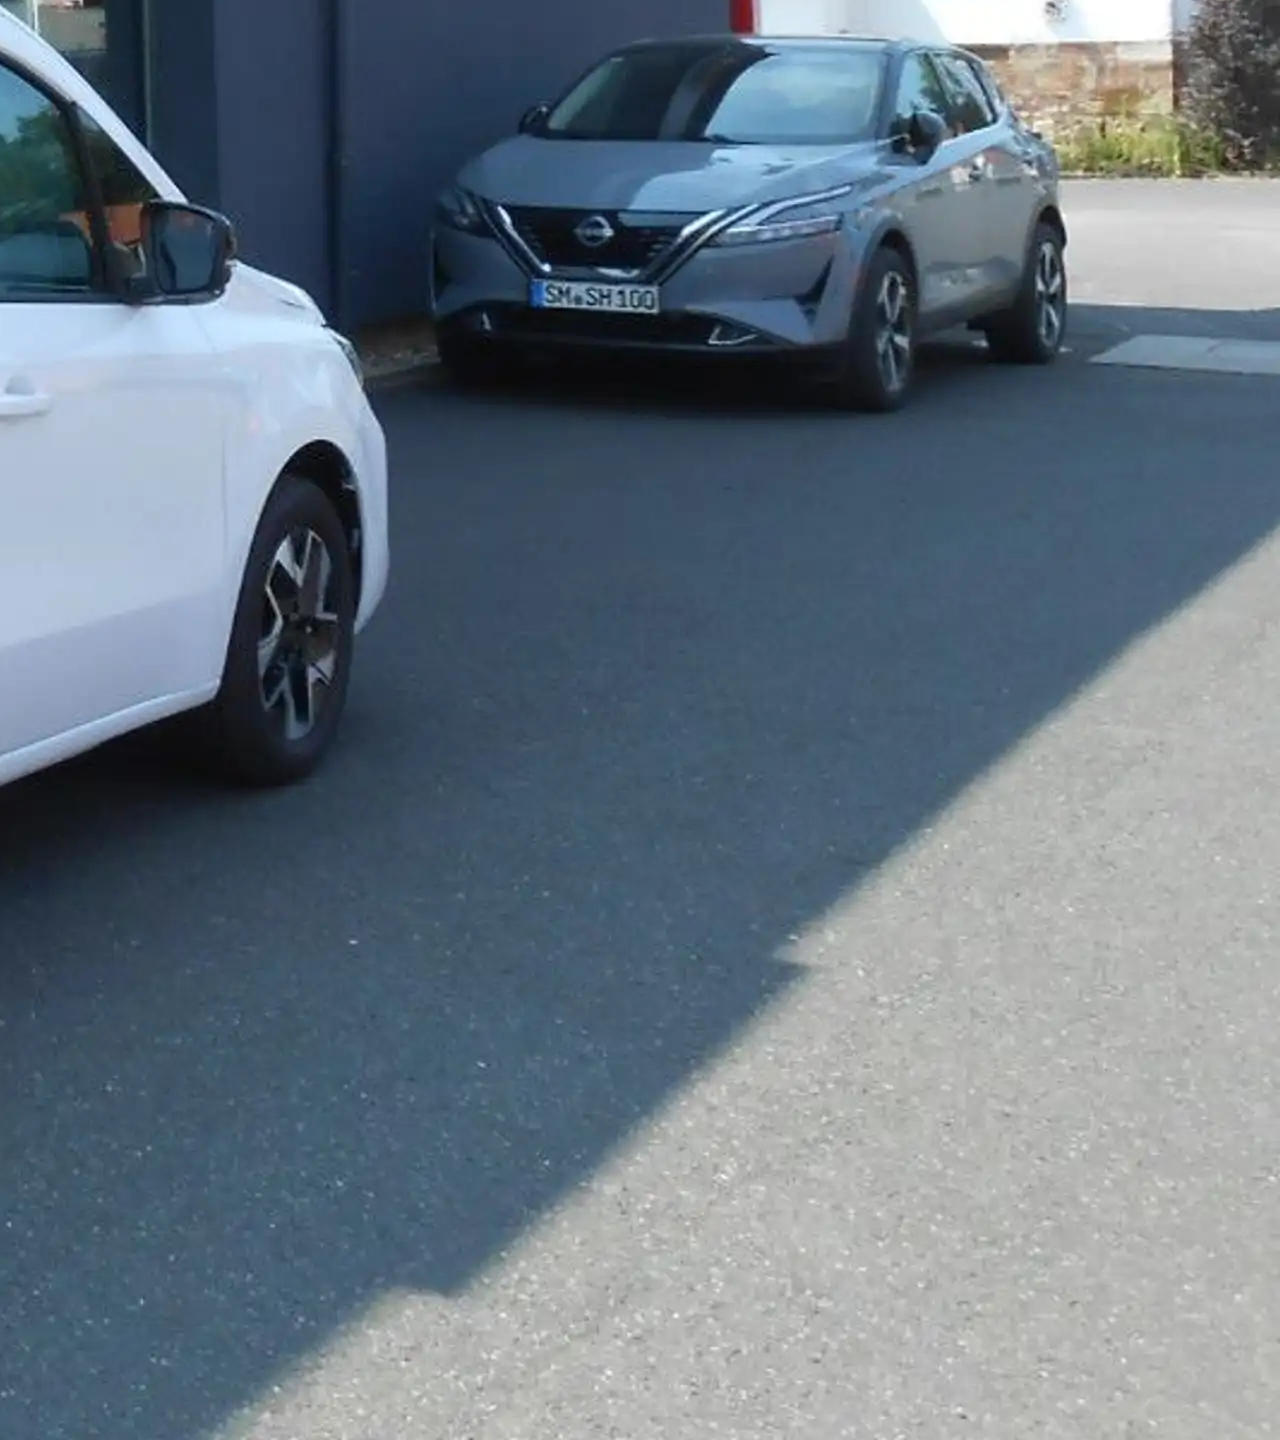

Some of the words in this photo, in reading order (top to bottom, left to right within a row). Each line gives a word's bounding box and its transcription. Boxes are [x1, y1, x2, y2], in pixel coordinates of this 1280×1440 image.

[545, 284, 571, 304] SM
[586, 285, 612, 307] SH
[616, 288, 656, 311] 100
